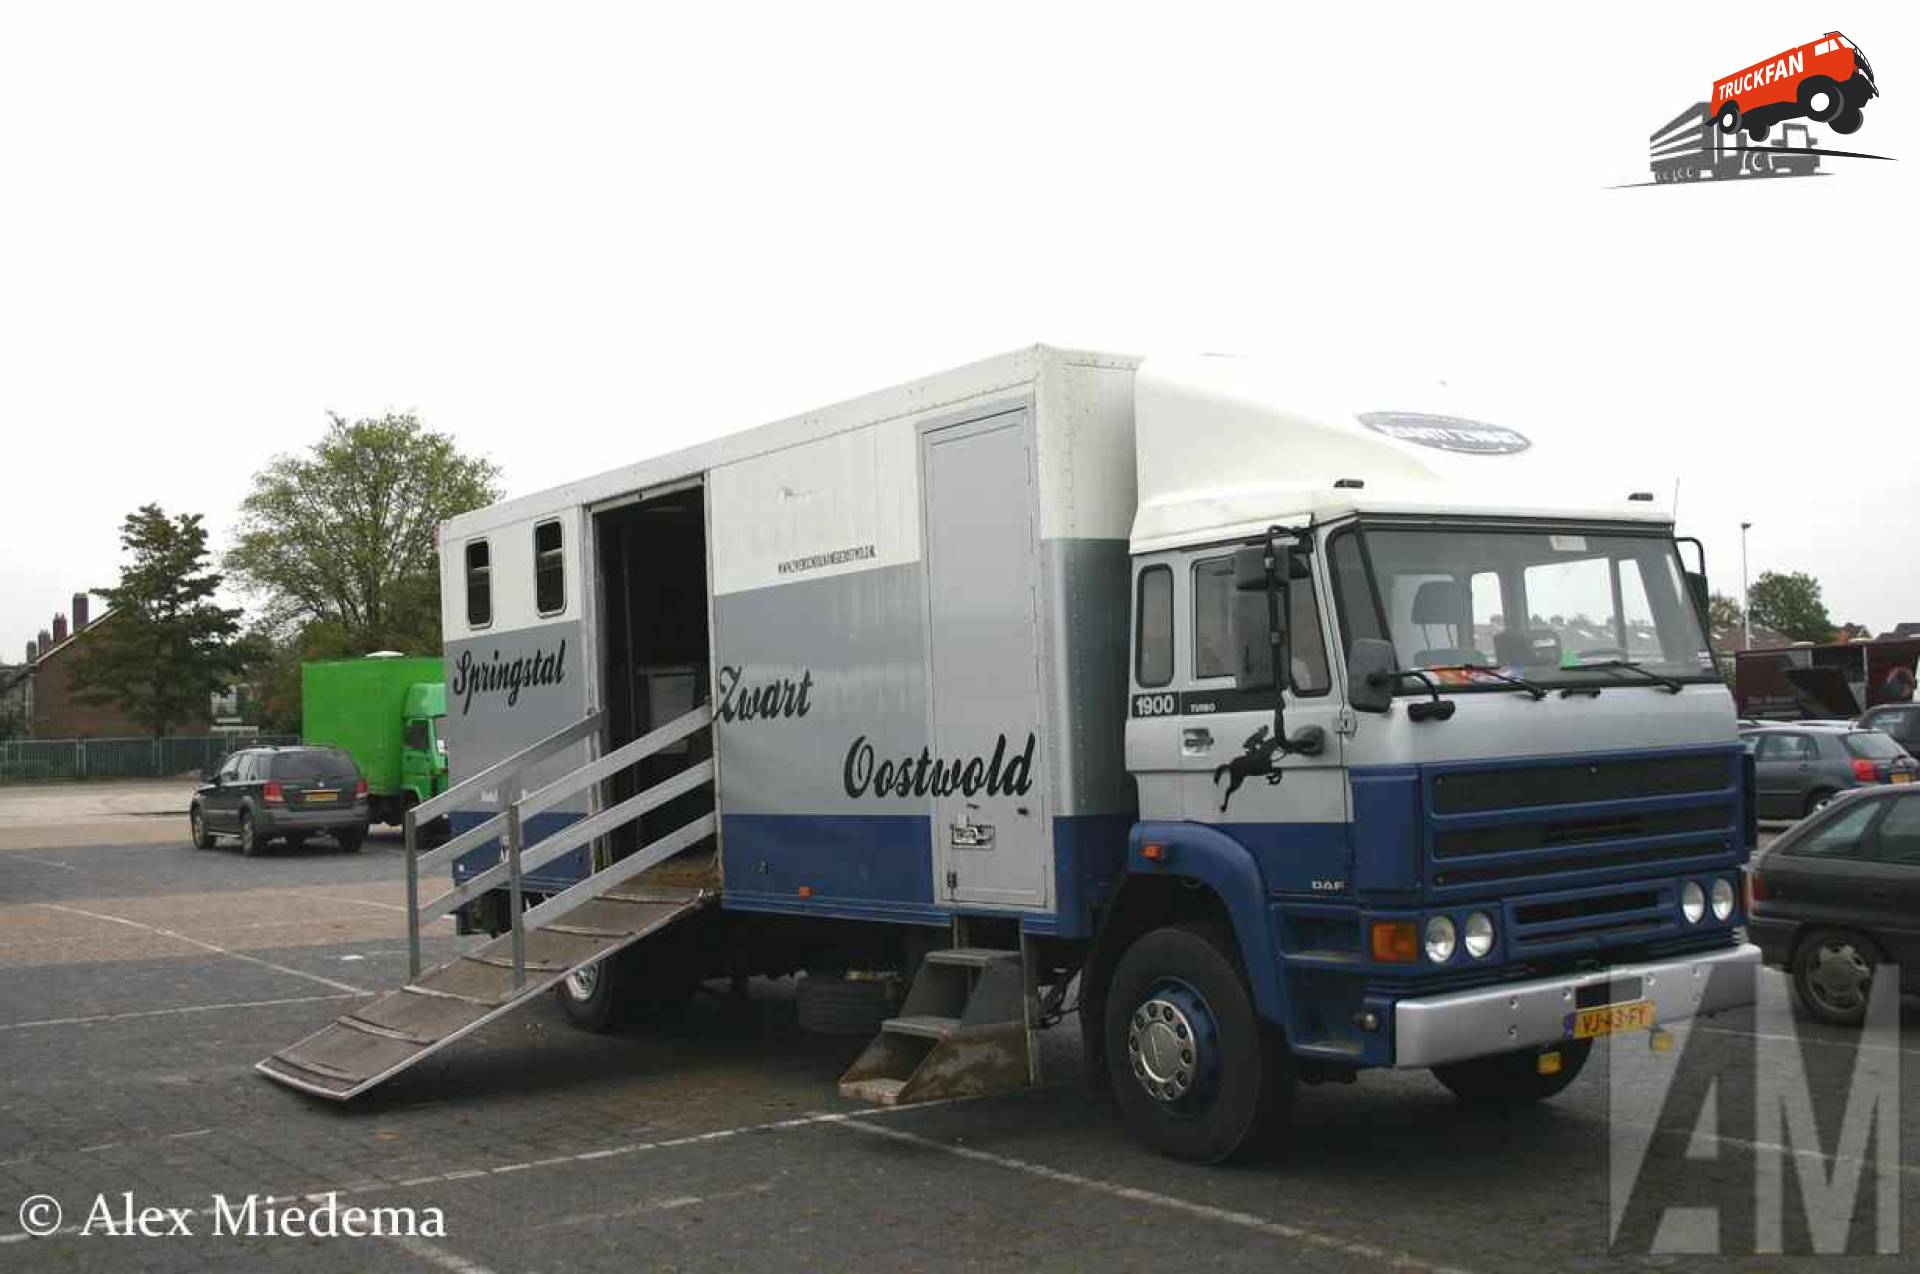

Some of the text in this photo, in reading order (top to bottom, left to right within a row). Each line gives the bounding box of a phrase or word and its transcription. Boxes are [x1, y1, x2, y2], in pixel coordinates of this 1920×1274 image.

[453, 639, 566, 715] Springstal
[712, 665, 813, 723] Zwart
[1136, 695, 1174, 716] 1900
[843, 732, 1036, 798] Oostwold
[1311, 881, 1345, 890] DAF
